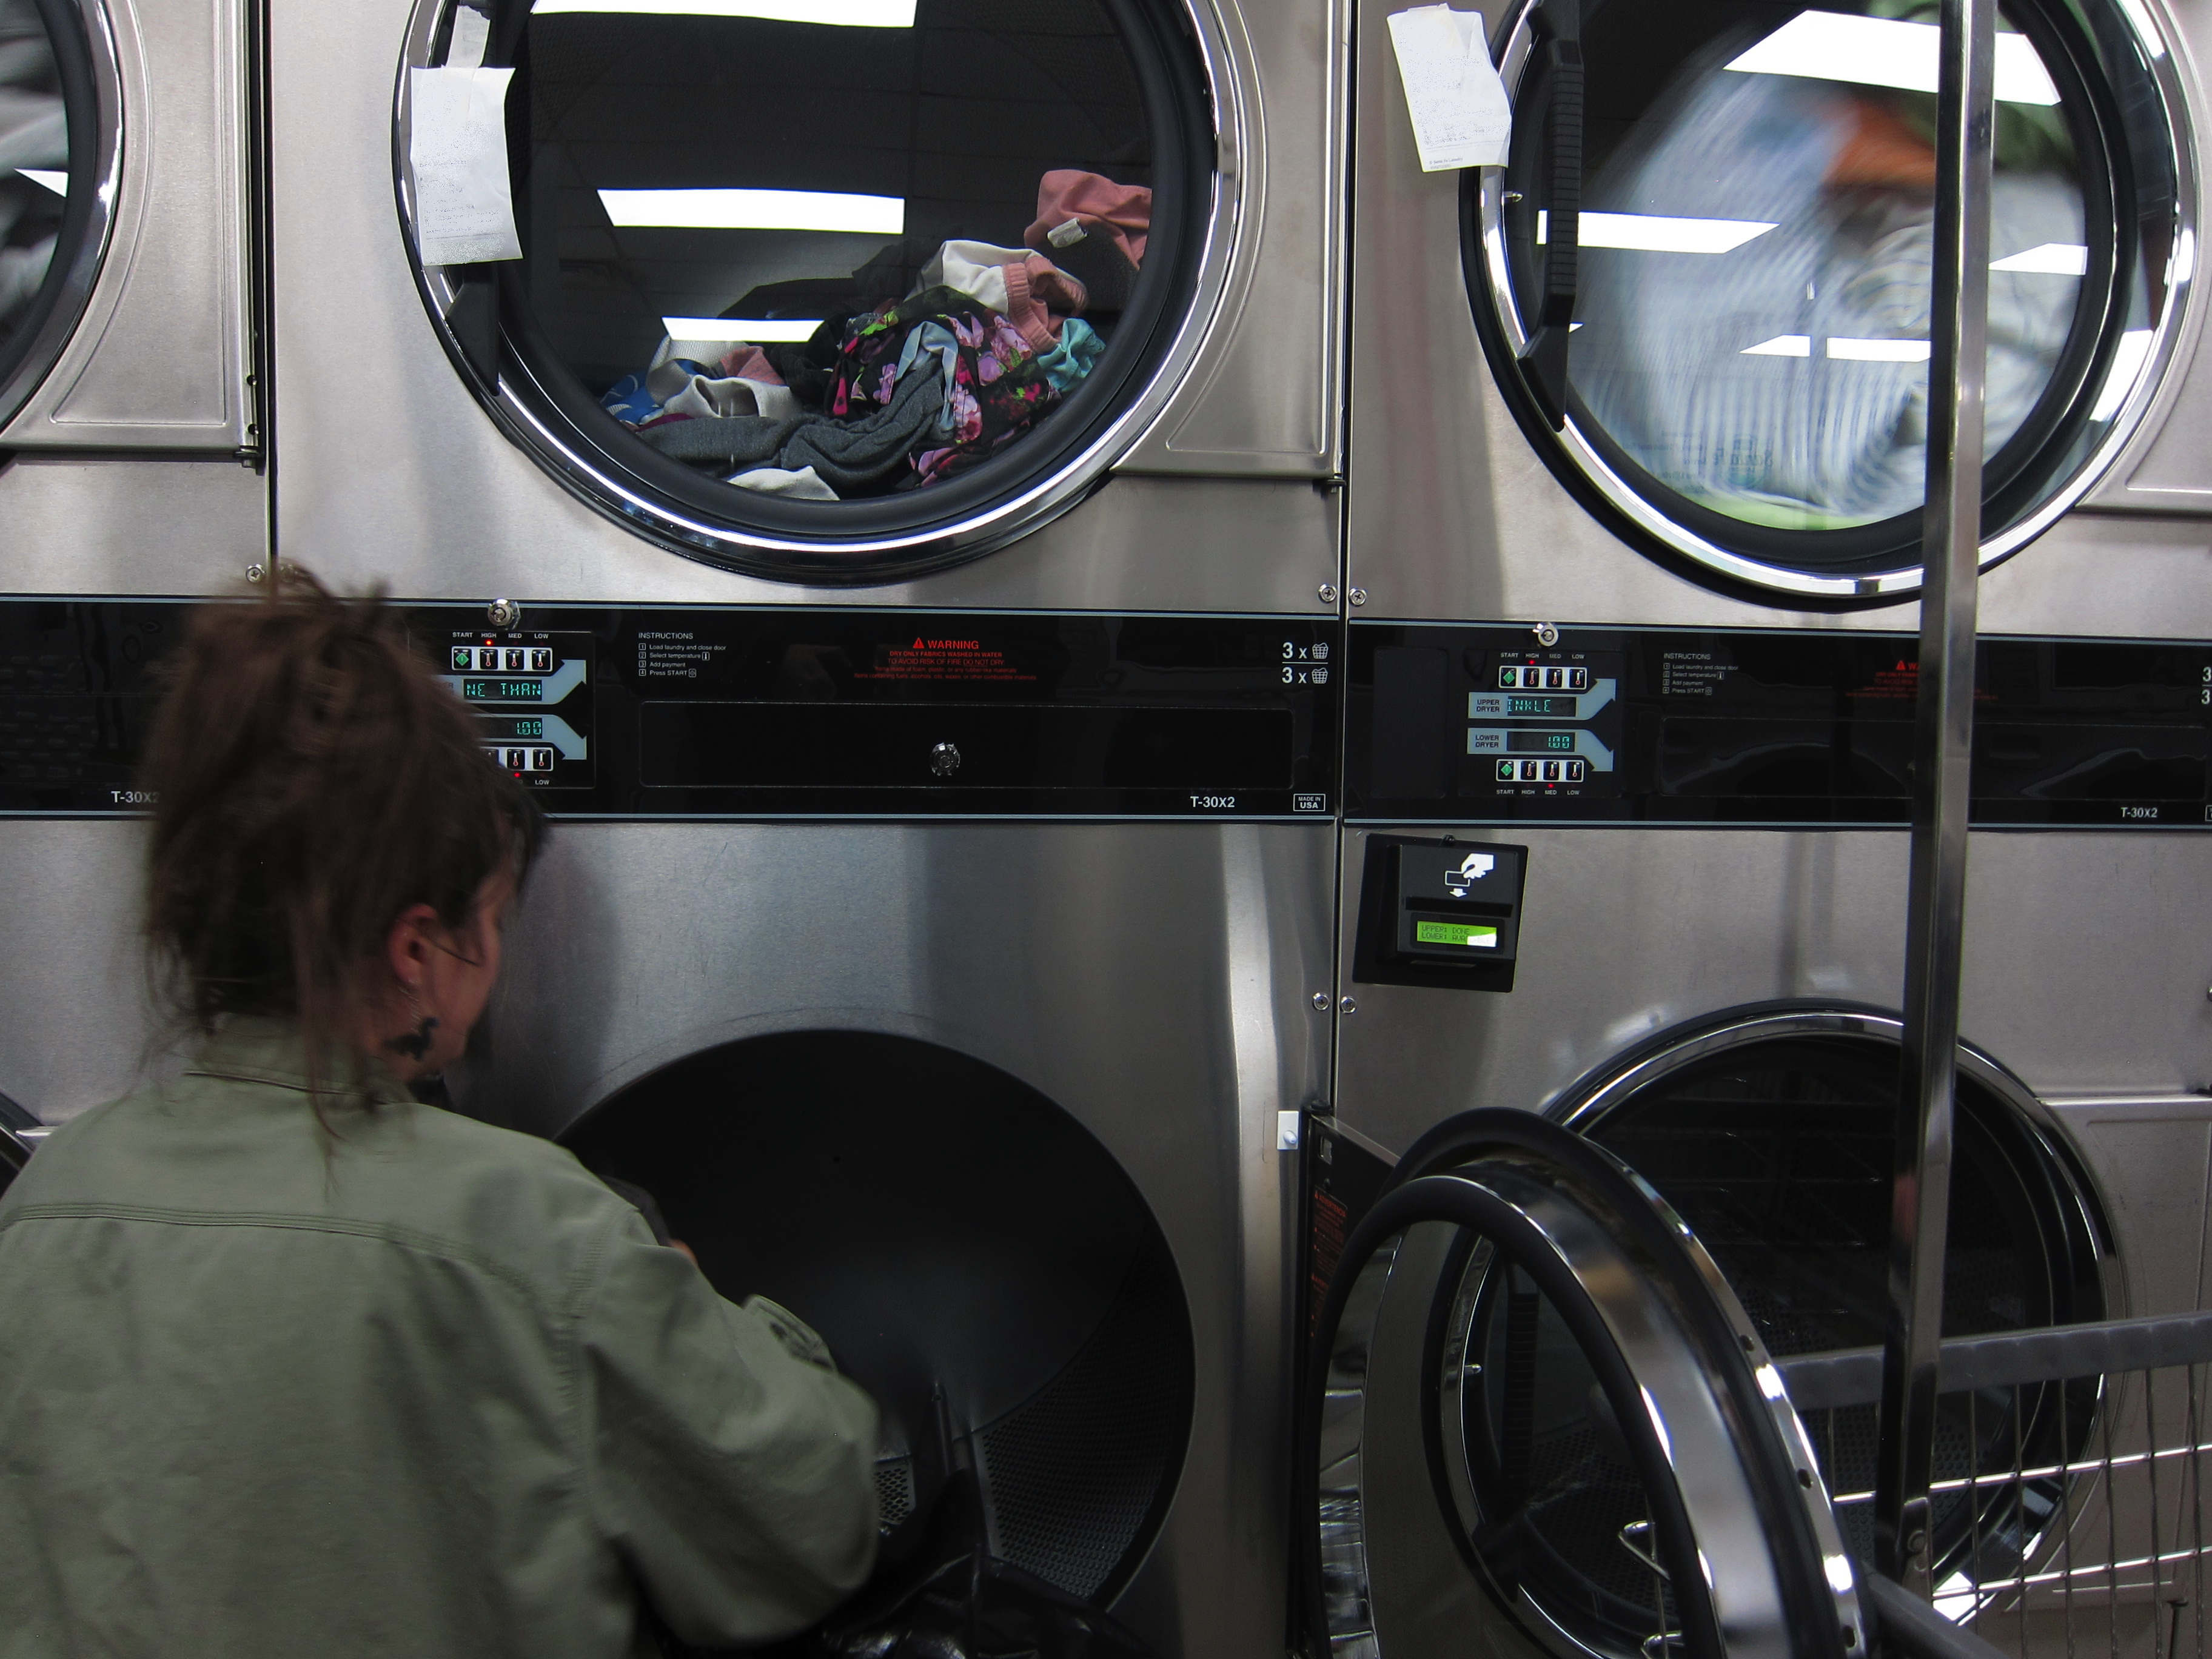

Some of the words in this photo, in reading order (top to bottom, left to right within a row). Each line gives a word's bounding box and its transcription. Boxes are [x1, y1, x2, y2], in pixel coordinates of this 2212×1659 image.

[928, 640, 979, 649] WARNING
[1282, 642, 1293, 659] 3
[1298, 648, 1307, 659] x
[1282, 666, 1293, 683] 3
[1298, 672, 1307, 684] x
[2203, 667, 2211, 682] 3
[466, 683, 486, 697] NE
[500, 683, 541, 696] THAN
[2201, 689, 2211, 705] 3
[1190, 796, 1235, 808] T-30X2
[2120, 807, 2157, 818] T-30X2
